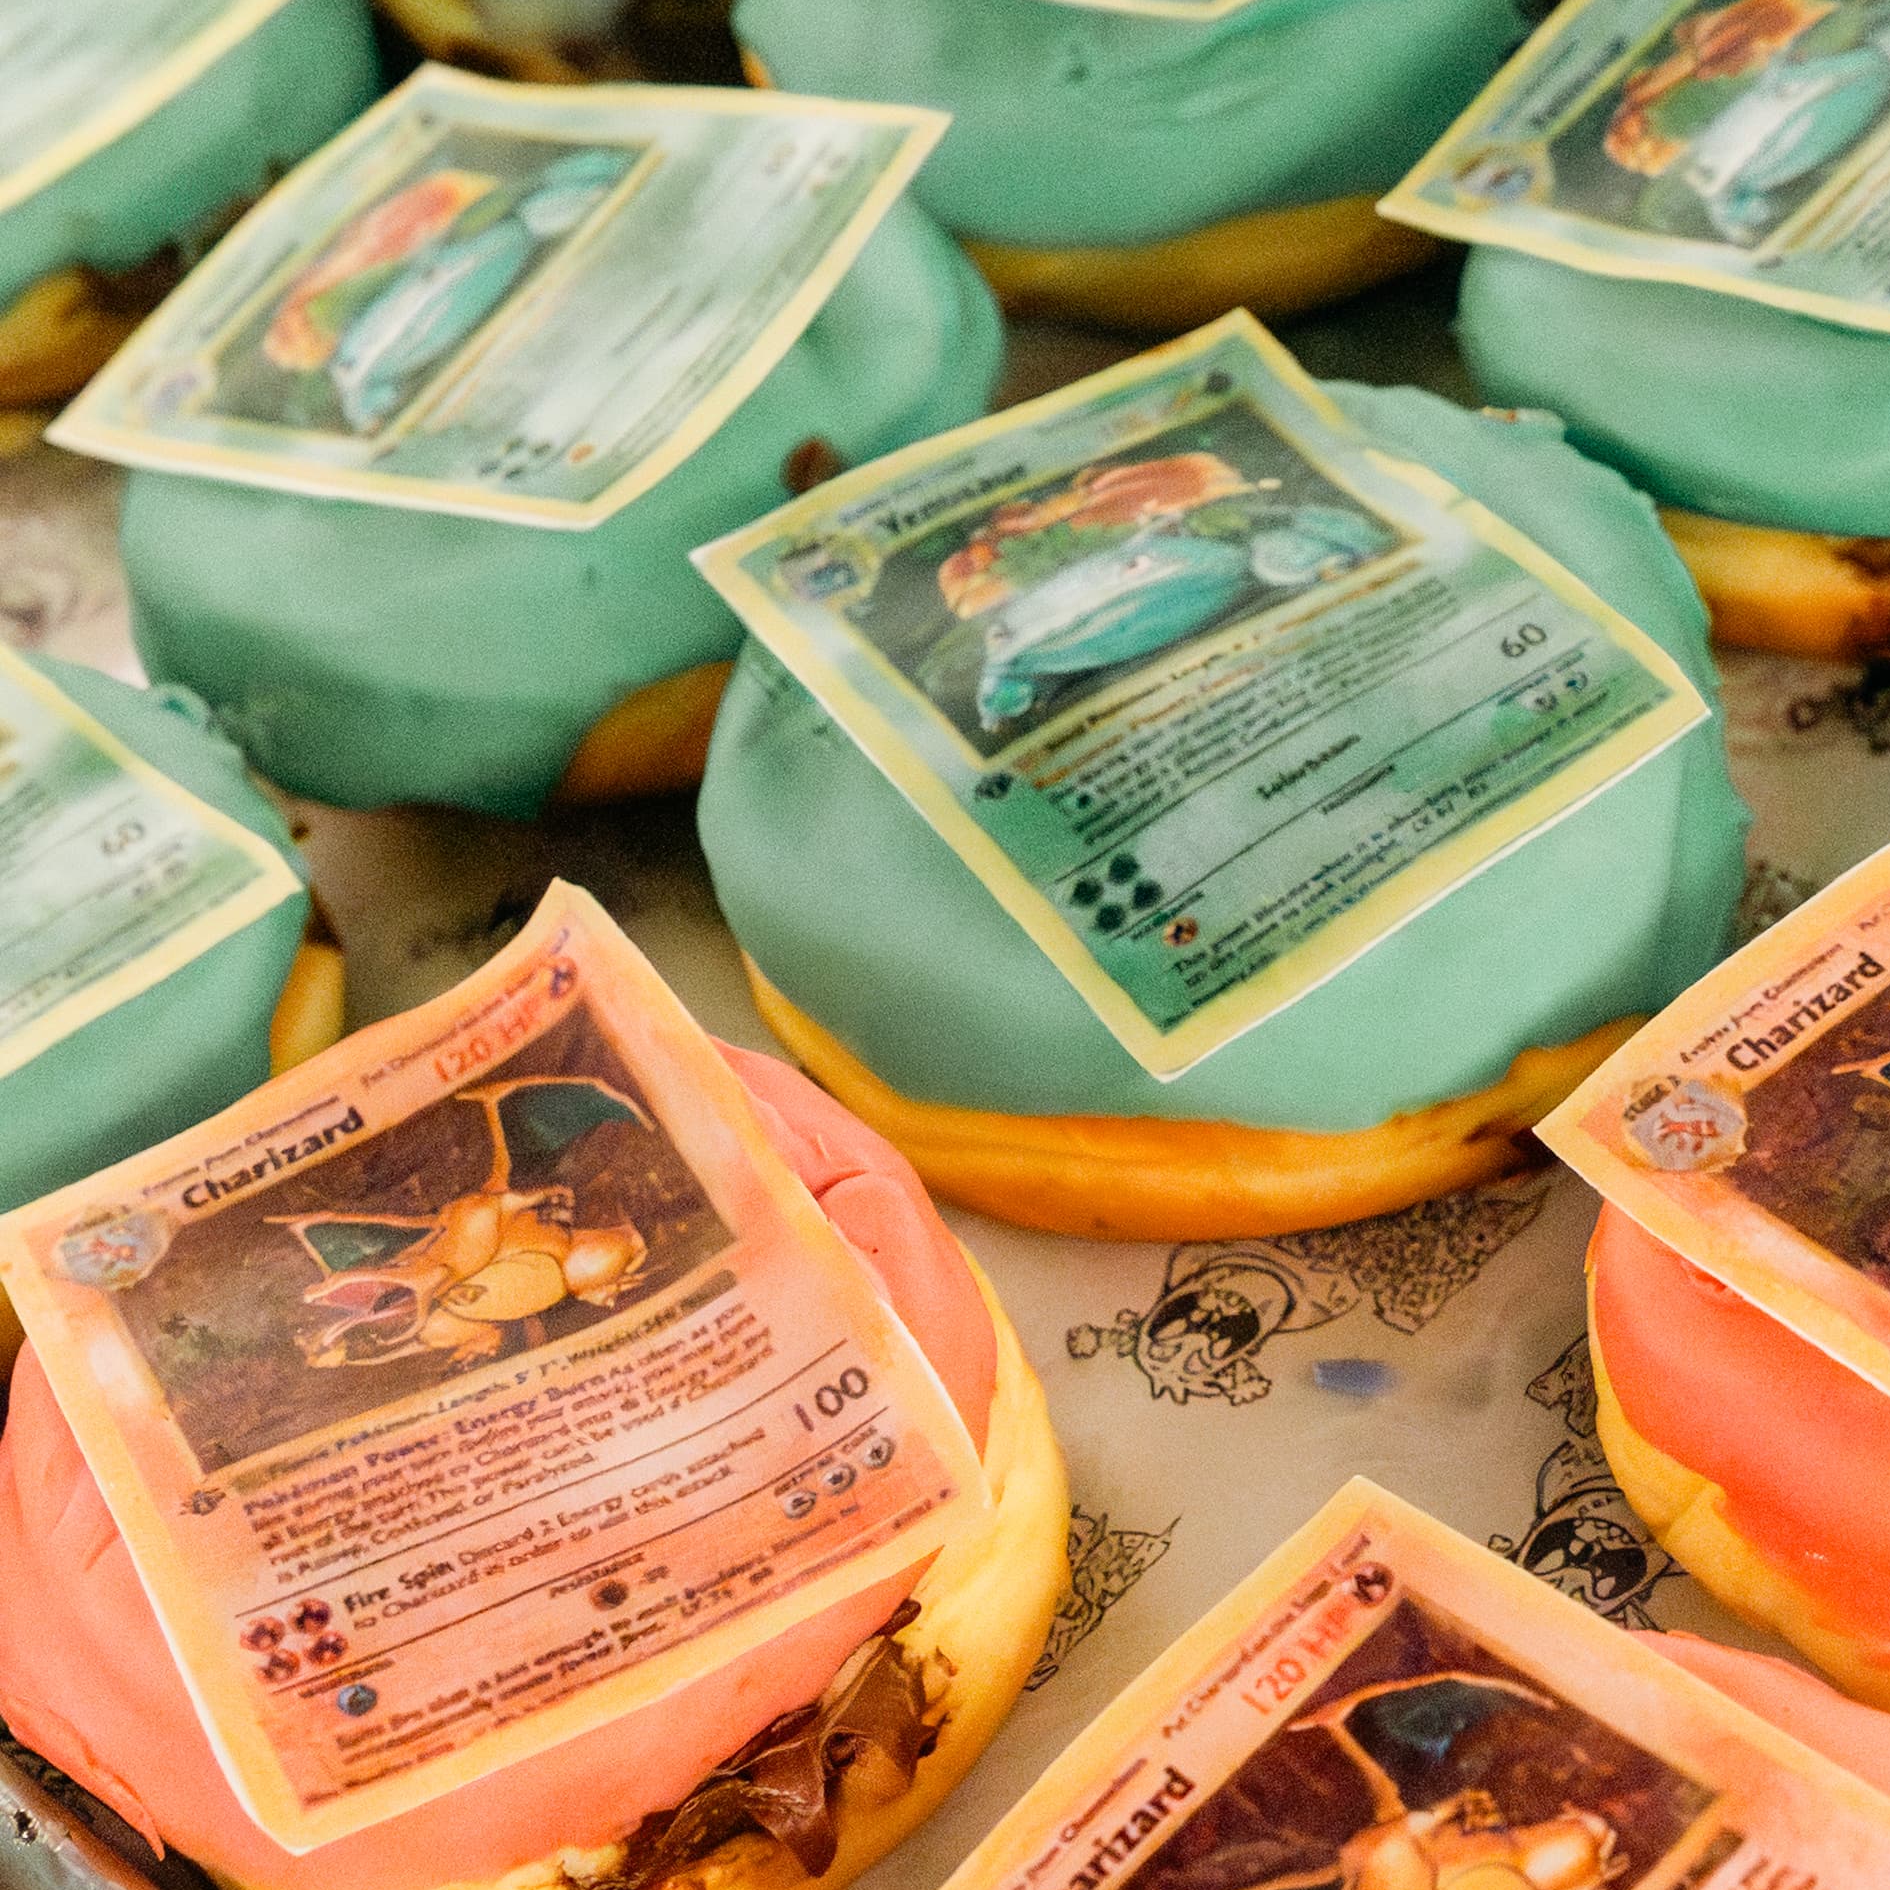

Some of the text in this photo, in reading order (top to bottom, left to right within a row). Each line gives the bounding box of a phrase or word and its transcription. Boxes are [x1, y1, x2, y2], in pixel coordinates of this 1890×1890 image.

[1490, 617, 1552, 661] 60
[1717, 946, 1890, 1077] Charizard
[428, 1029, 497, 1085] 120
[176, 1091, 369, 1226] Charizard
[450, 1379, 545, 1450] Energy
[540, 1361, 609, 1412] Burn
[784, 1360, 884, 1436] 100
[339, 1576, 395, 1620] Fire
[394, 1549, 459, 1599] Spin
[1236, 1651, 1315, 1719] 120
